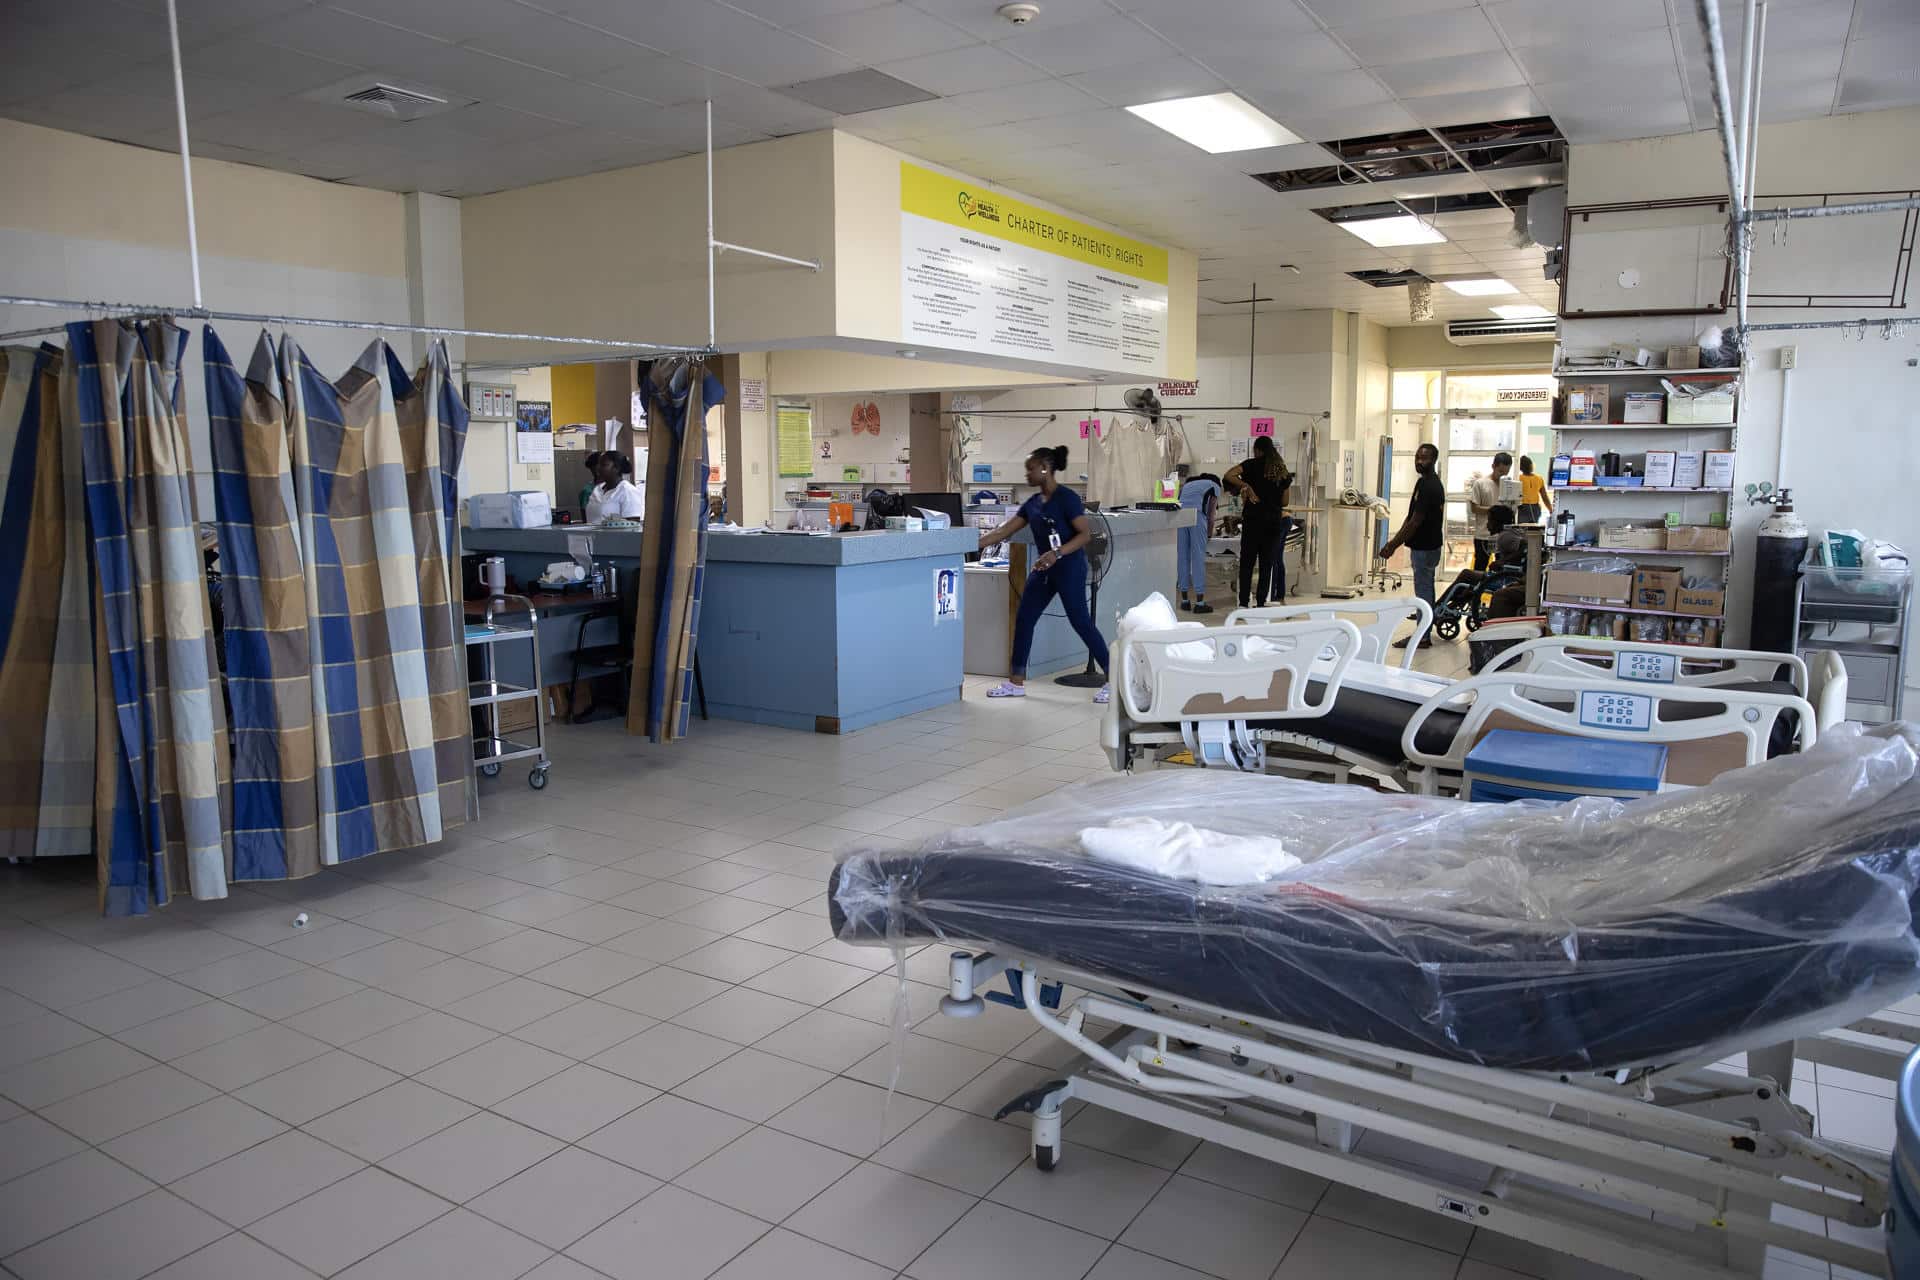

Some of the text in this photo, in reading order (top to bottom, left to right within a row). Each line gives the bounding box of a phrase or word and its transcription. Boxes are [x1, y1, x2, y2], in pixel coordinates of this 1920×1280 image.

[1007, 213, 1054, 240] CHARTER
[1057, 229, 1069, 244] OF
[1115, 248, 1144, 267] RIGHTS
[1160, 388, 1197, 396] CUBICLE
[1256, 423, 1269, 433] E1
[1682, 597, 1713, 606] GLASS
